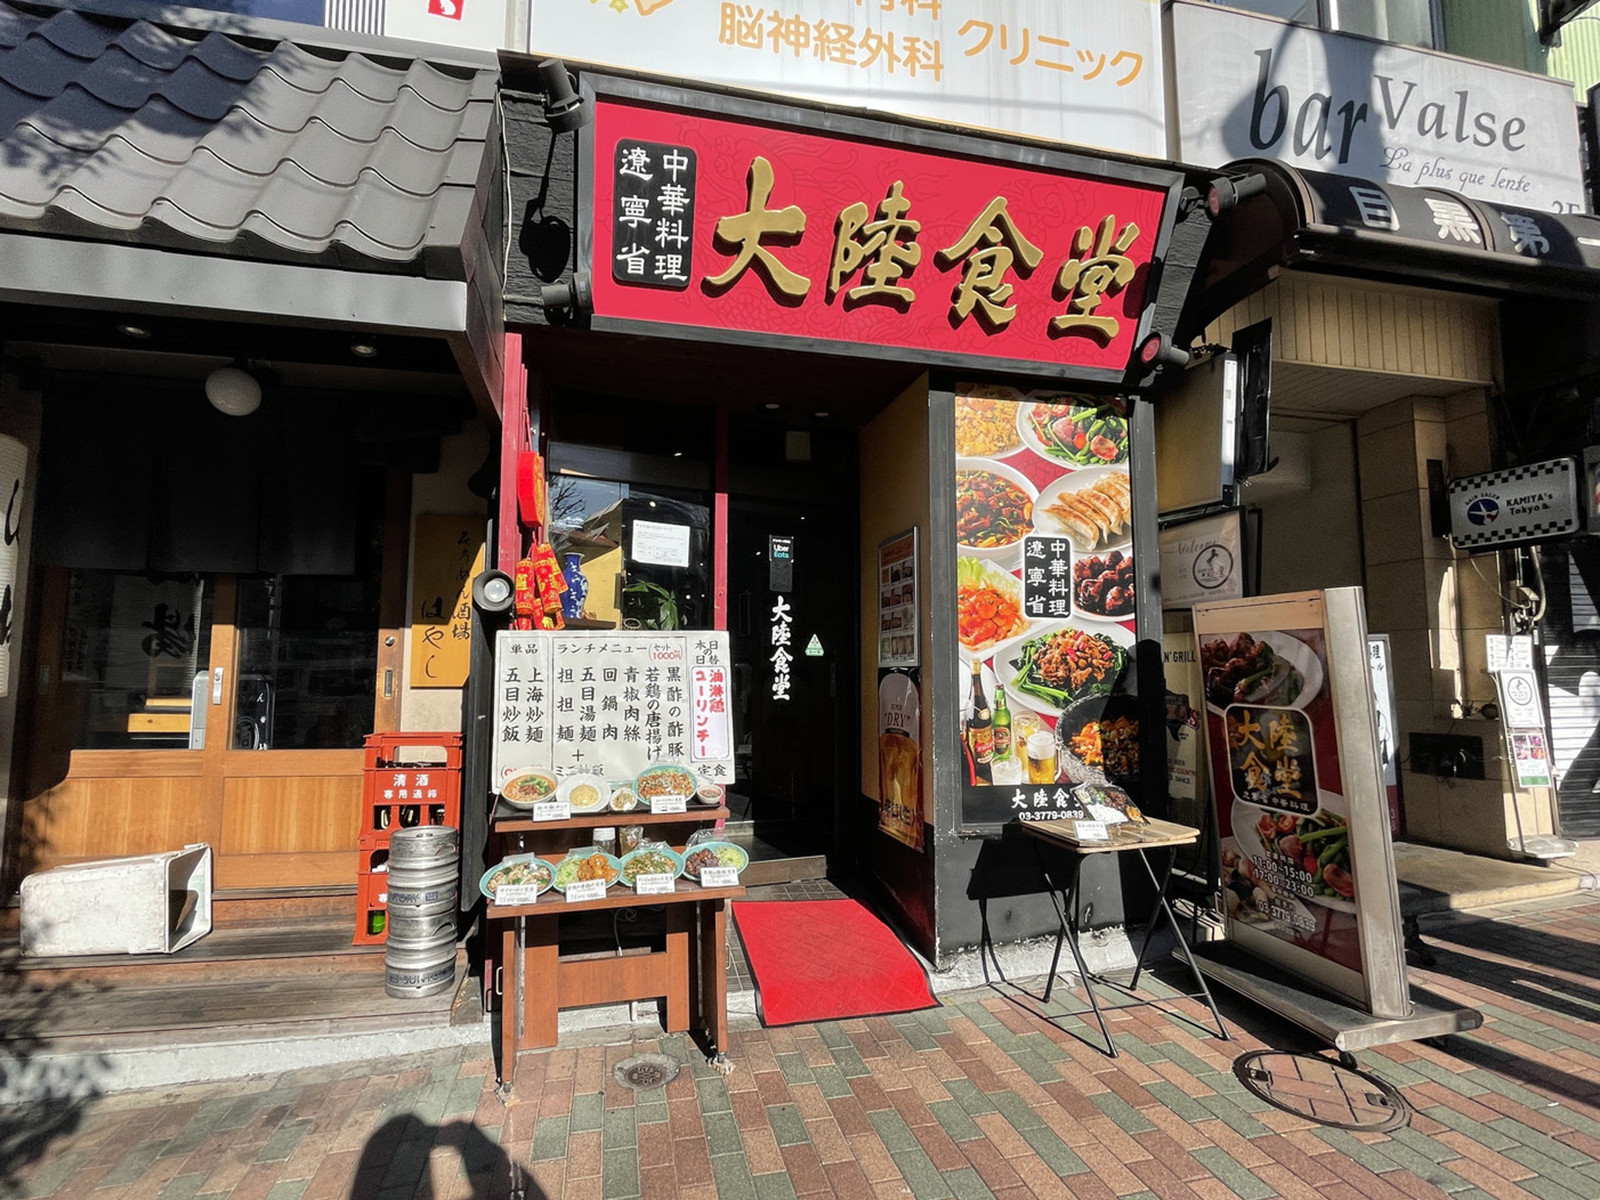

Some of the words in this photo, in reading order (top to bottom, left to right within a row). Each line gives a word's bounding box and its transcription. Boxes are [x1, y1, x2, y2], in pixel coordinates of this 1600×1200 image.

[719, 3, 944, 82] 脳神経外科
[958, 19, 1143, 87] クリニック
[1250, 49, 1368, 165] bar
[1374, 74, 1526, 152] Valse
[1379, 146, 1412, 172] La
[1414, 156, 1453, 185] plus
[1459, 170, 1485, 192] que
[1491, 166, 1531, 192] lente
[616, 146, 653, 275] 遼寧省
[654, 149, 690, 282] 中華料理
[703, 155, 1141, 343] 大陸食堂
[1510, 505, 1540, 515] Tokyo
[1048, 540, 1069, 616] 中華料理
[510, 643, 538, 654] 単品
[557, 643, 647, 655] ランチメニュー
[769, 595, 793, 701] 大陸食堂
[502, 667, 521, 743] 五目炒飯
[602, 667, 618, 741] 回鍋肉
[645, 666, 662, 761] 若鶏の唐揚げ
[666, 666, 685, 757] 黒酢の酢豚
[1238, 709, 1299, 752] 大陸
[698, 763, 727, 777] 定食
[1011, 787, 1083, 809] 大陸食
[1239, 751, 1303, 799] 食堂
[1018, 810, 1085, 822] 03-3779-0839
